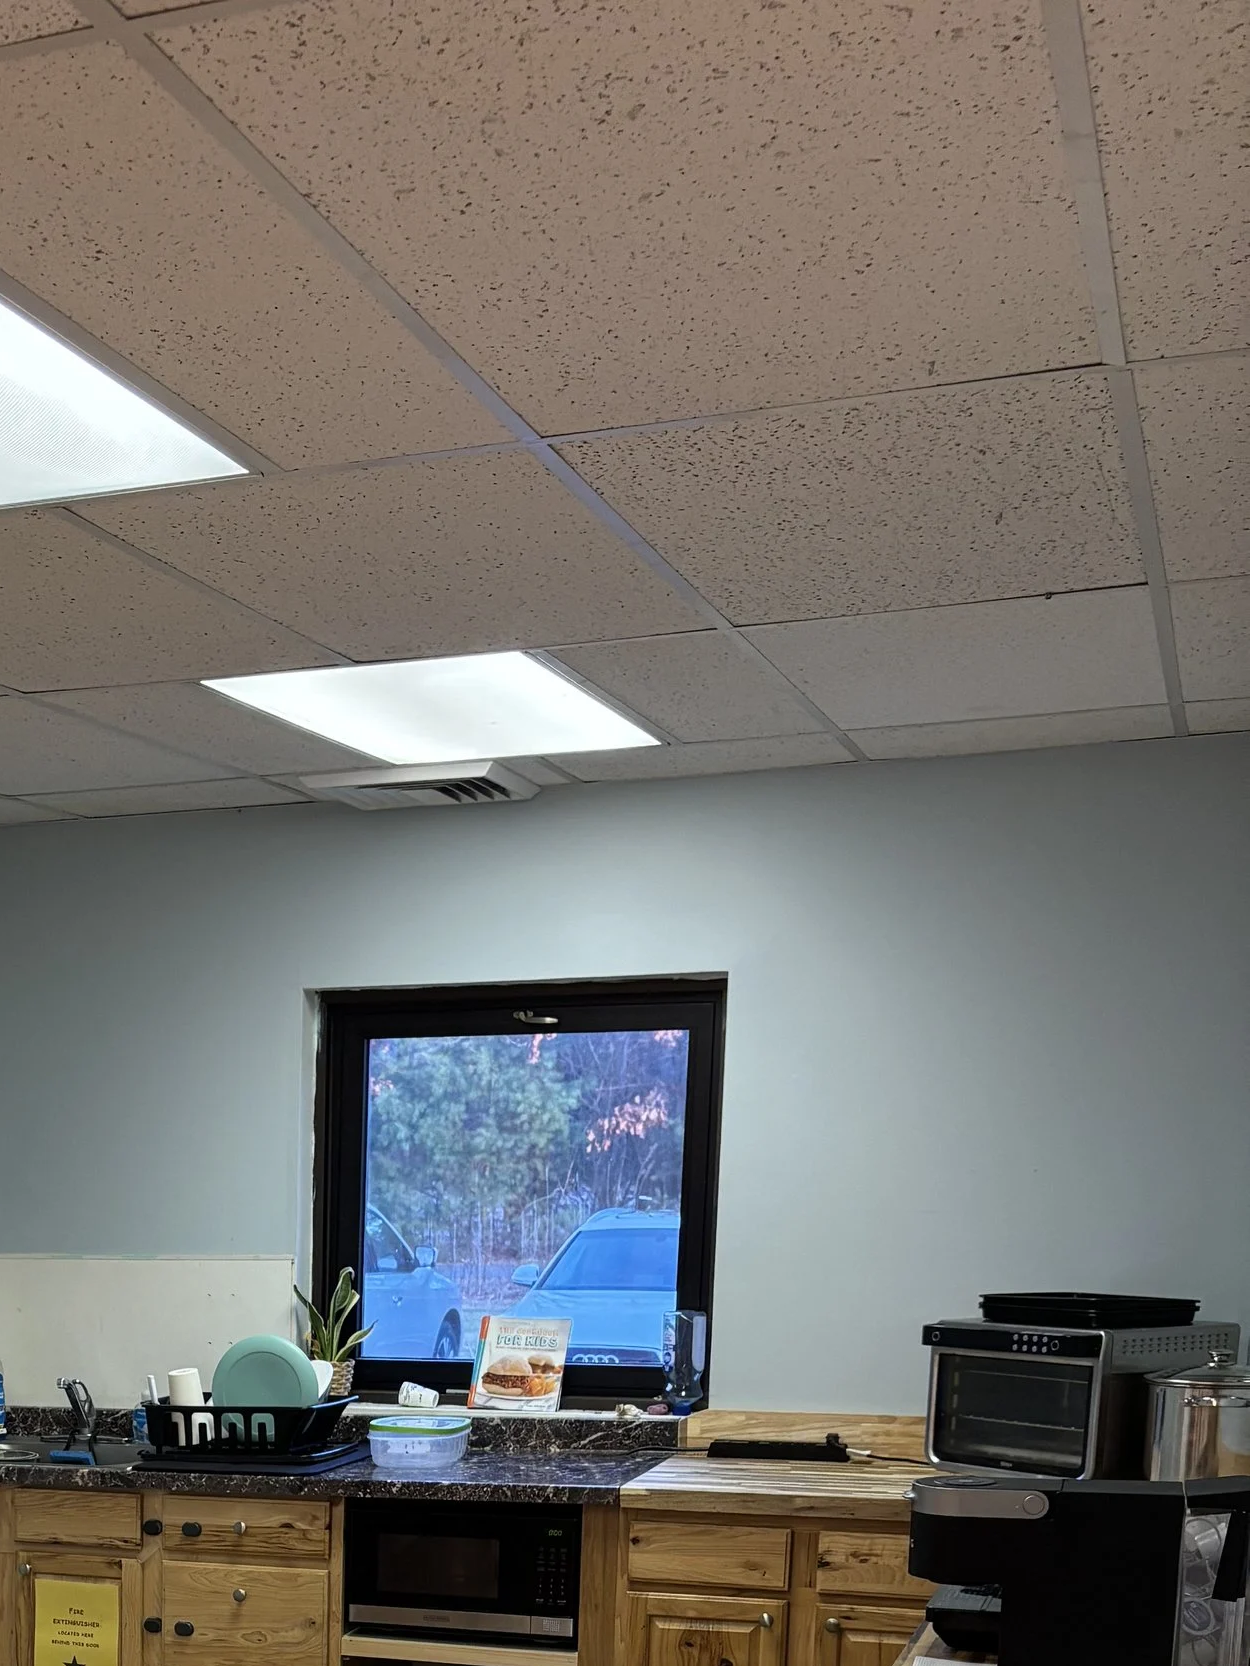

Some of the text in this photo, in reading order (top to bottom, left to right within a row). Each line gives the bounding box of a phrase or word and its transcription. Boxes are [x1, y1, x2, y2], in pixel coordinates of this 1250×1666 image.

[496, 1334, 558, 1348] FOR KIDS
[53, 1618, 100, 1628] EXTINGUISHER
